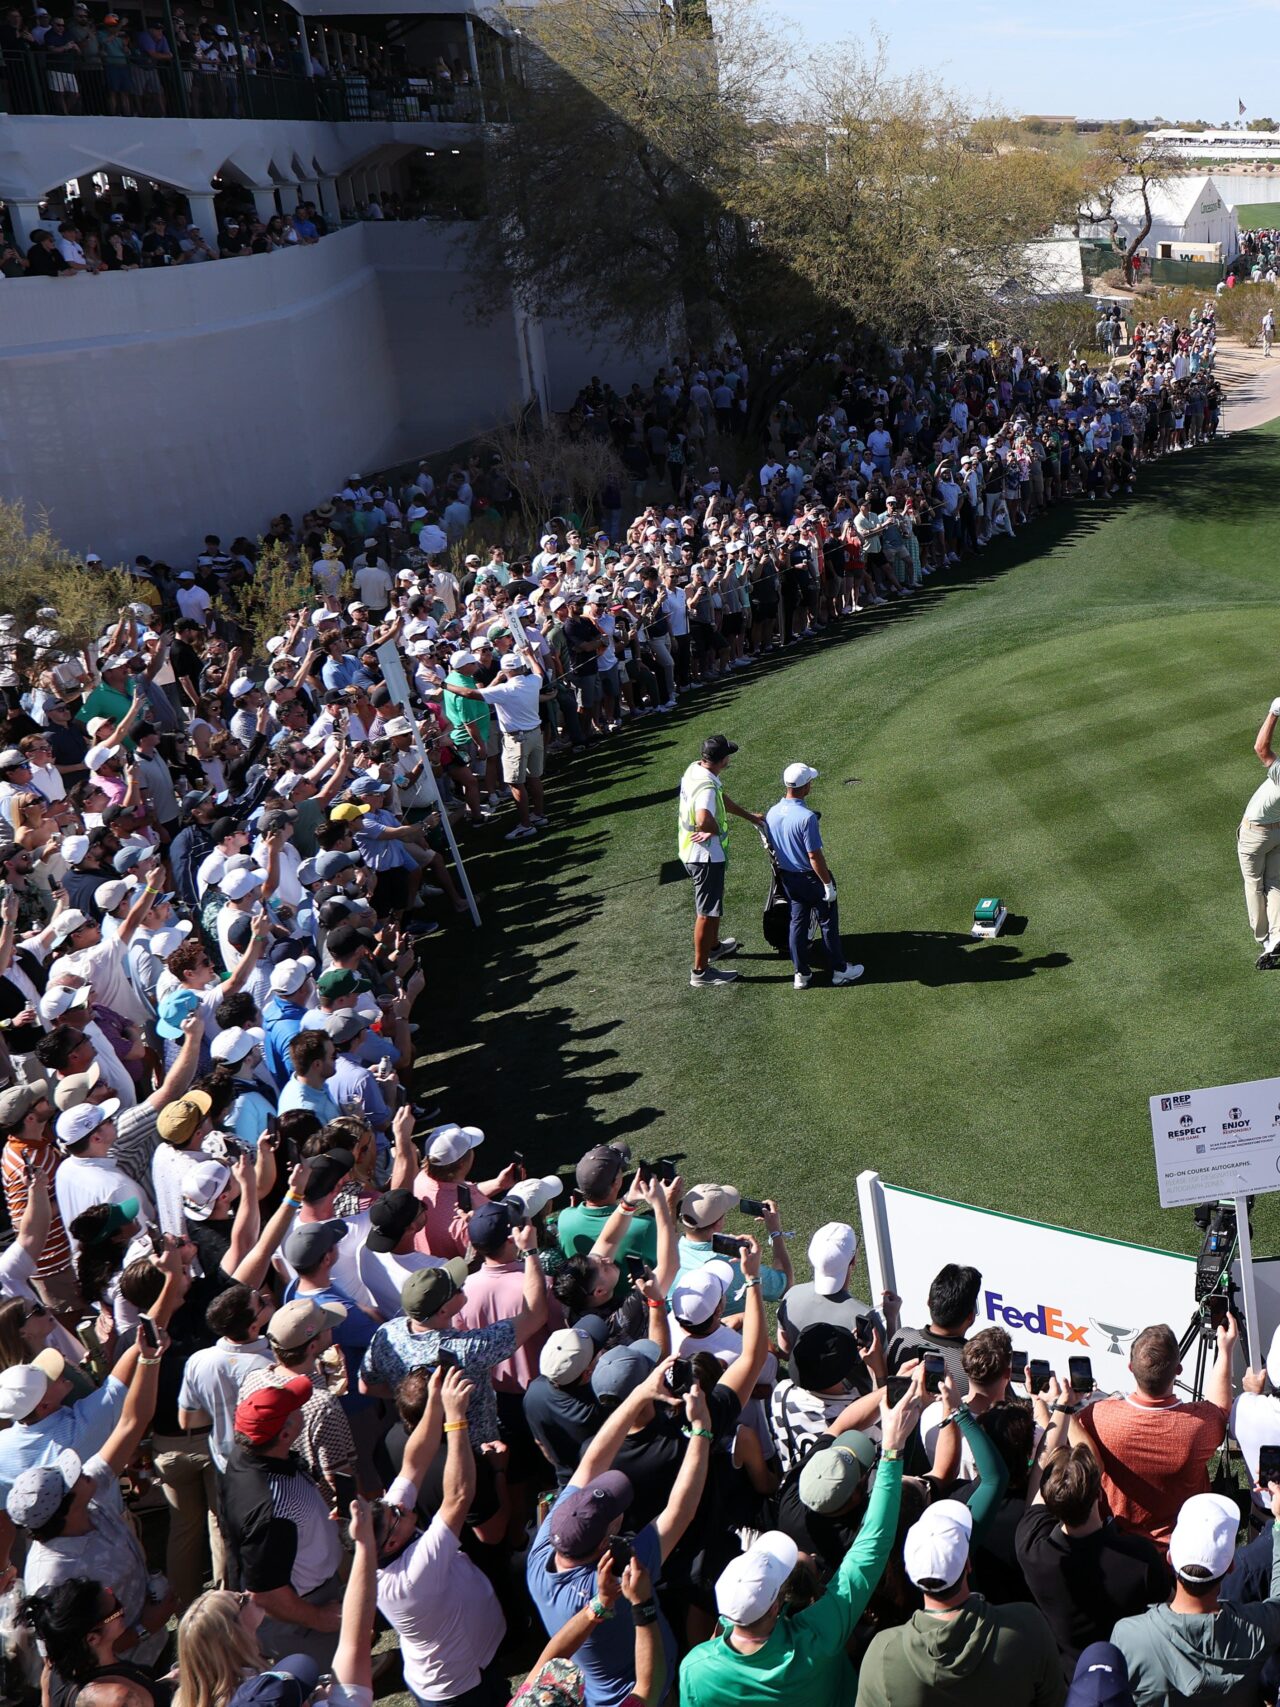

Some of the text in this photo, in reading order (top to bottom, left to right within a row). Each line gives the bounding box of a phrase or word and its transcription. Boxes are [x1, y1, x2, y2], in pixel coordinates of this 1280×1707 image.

[1172, 1094, 1191, 1104] REP
[1222, 1119, 1250, 1130] ENJOY
[1168, 1126, 1206, 1139] RESPECT
[1165, 1171, 1186, 1179] NO-ON
[1187, 1167, 1210, 1176] COURSE
[985, 1290, 1091, 1348] FedEx
